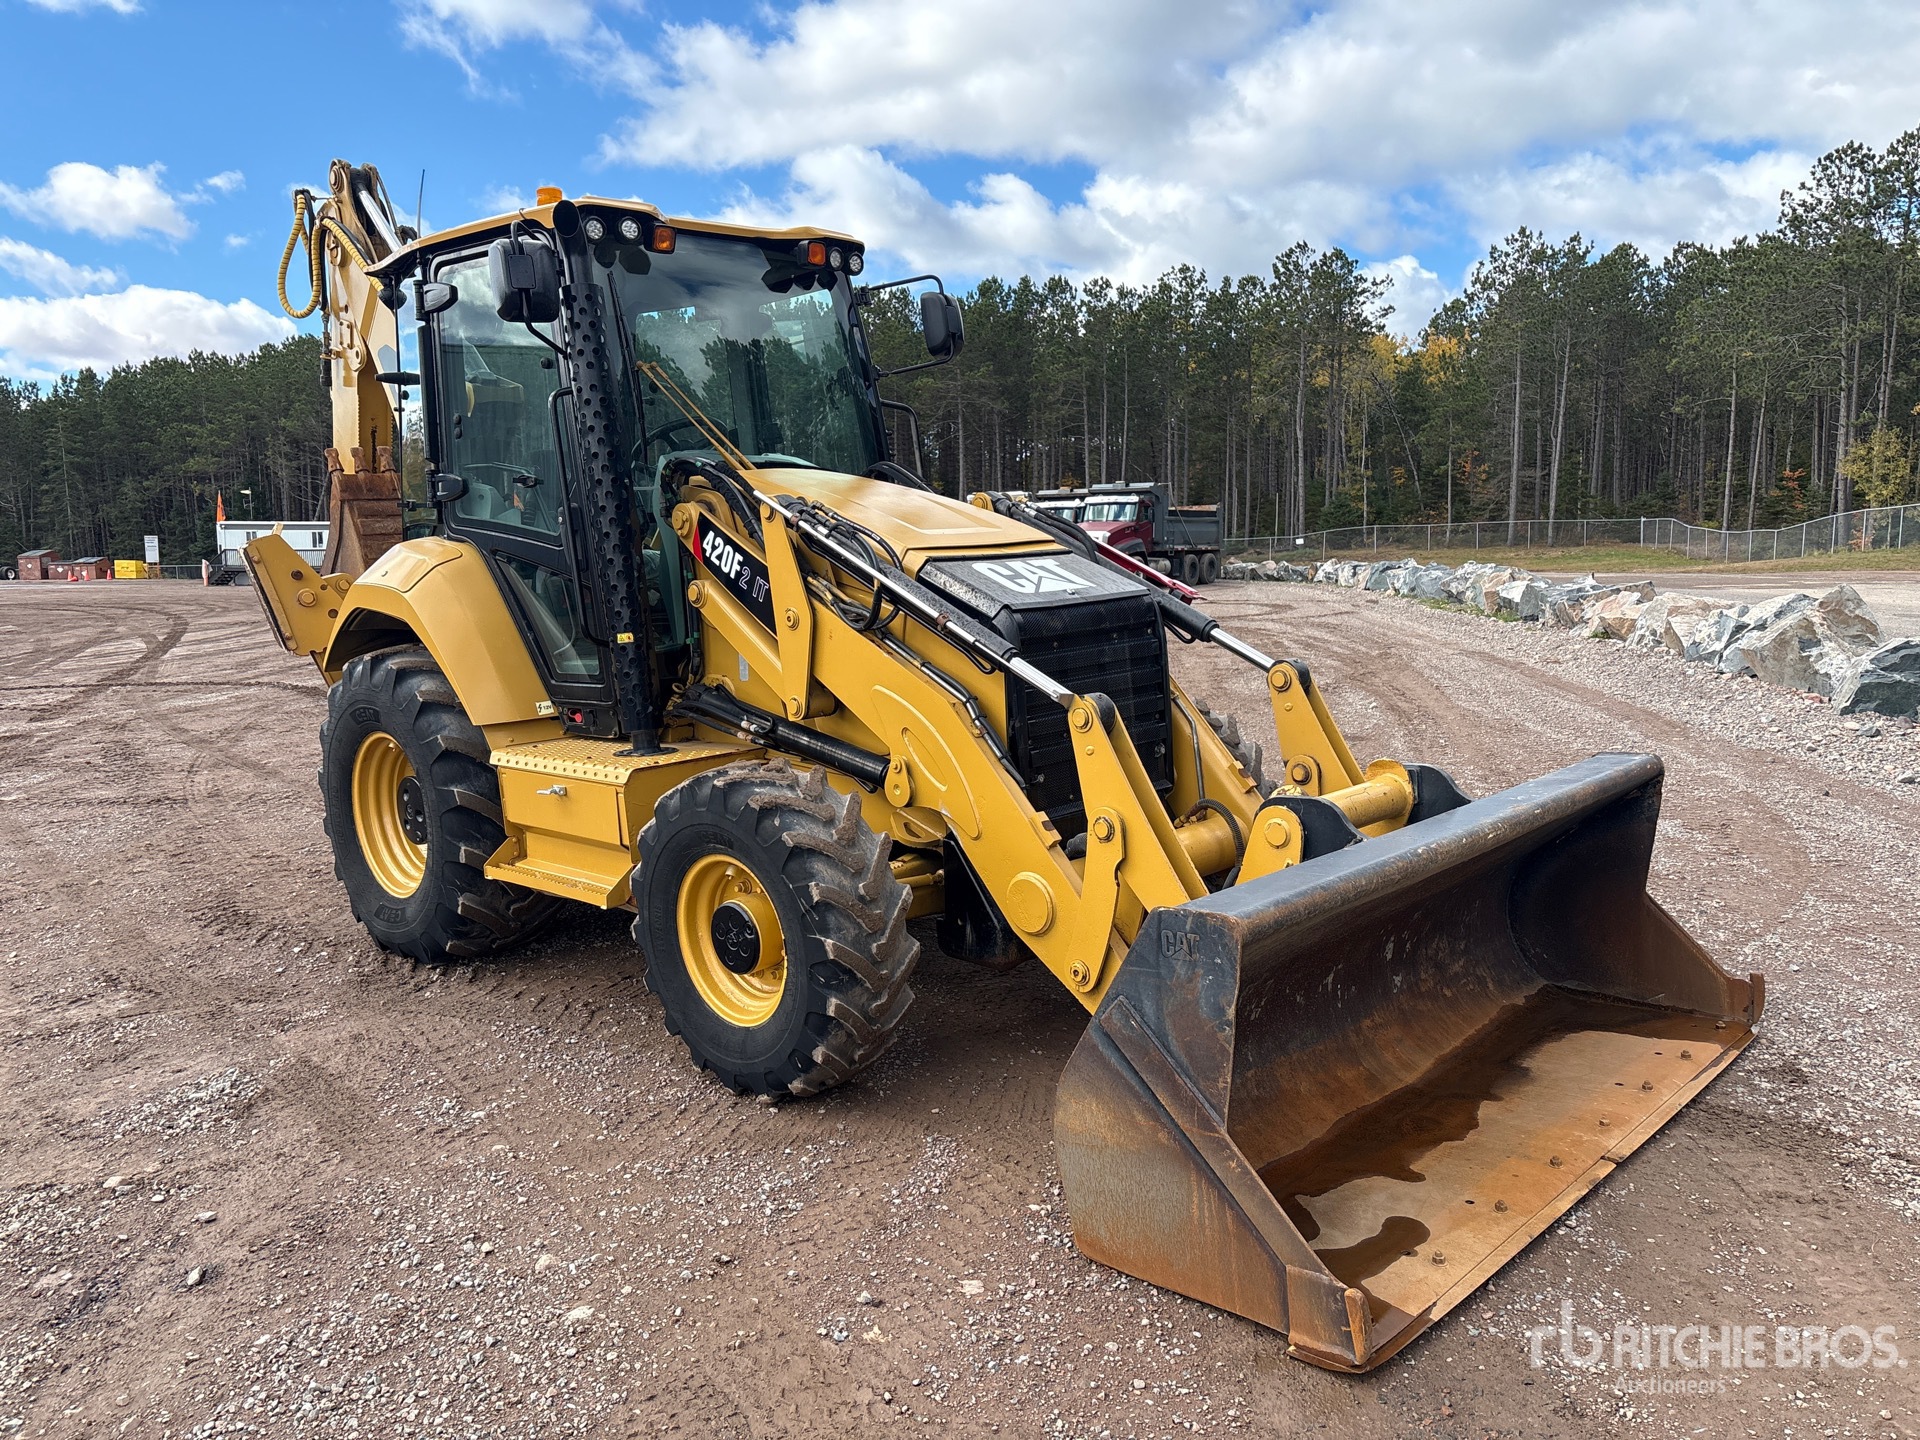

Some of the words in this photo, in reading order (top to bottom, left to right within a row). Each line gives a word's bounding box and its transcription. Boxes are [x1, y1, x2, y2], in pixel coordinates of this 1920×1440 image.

[752, 576, 769, 603] IT
[972, 558, 1097, 594] CAT
[1160, 929, 1200, 961] CAT
